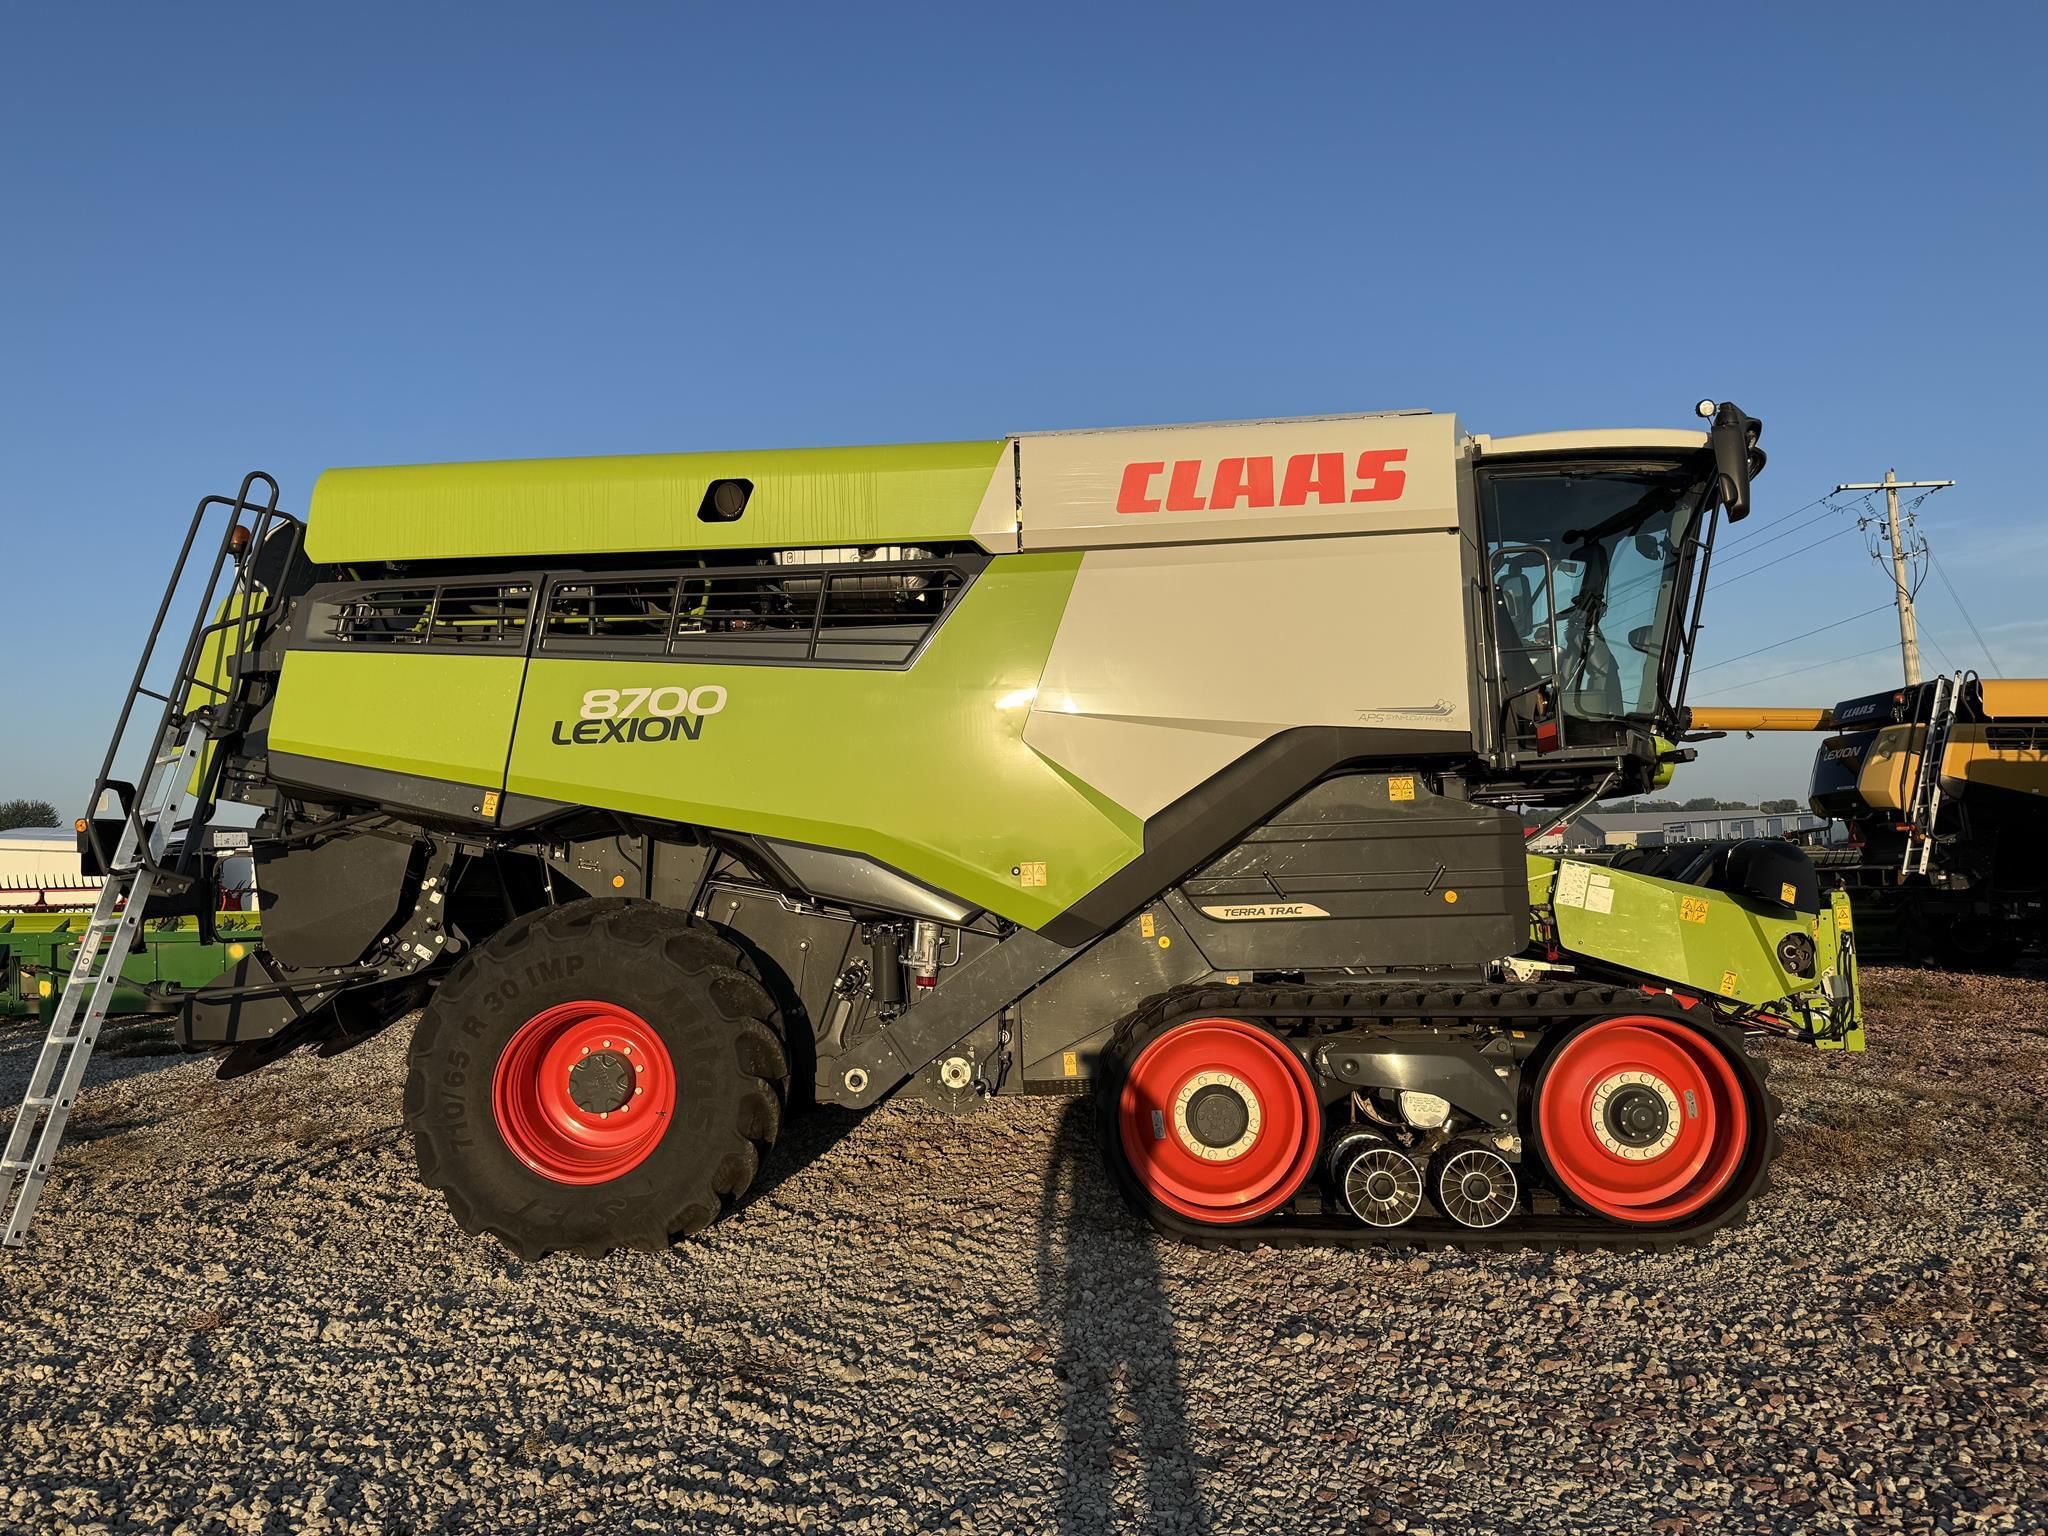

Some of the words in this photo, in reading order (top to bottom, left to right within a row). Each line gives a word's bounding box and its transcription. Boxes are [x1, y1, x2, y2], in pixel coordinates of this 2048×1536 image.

[1116, 448, 1408, 513] CLAAS
[580, 685, 728, 719] 8700
[551, 715, 704, 745] LEXION
[1358, 713, 1384, 722] APS
[1823, 746, 1862, 761] LEXION
[1224, 907, 1266, 917] TERRA
[1269, 906, 1304, 915] TRAC
[461, 1015, 489, 1039] R
[483, 979, 520, 1014] 30
[525, 955, 585, 987] IMP
